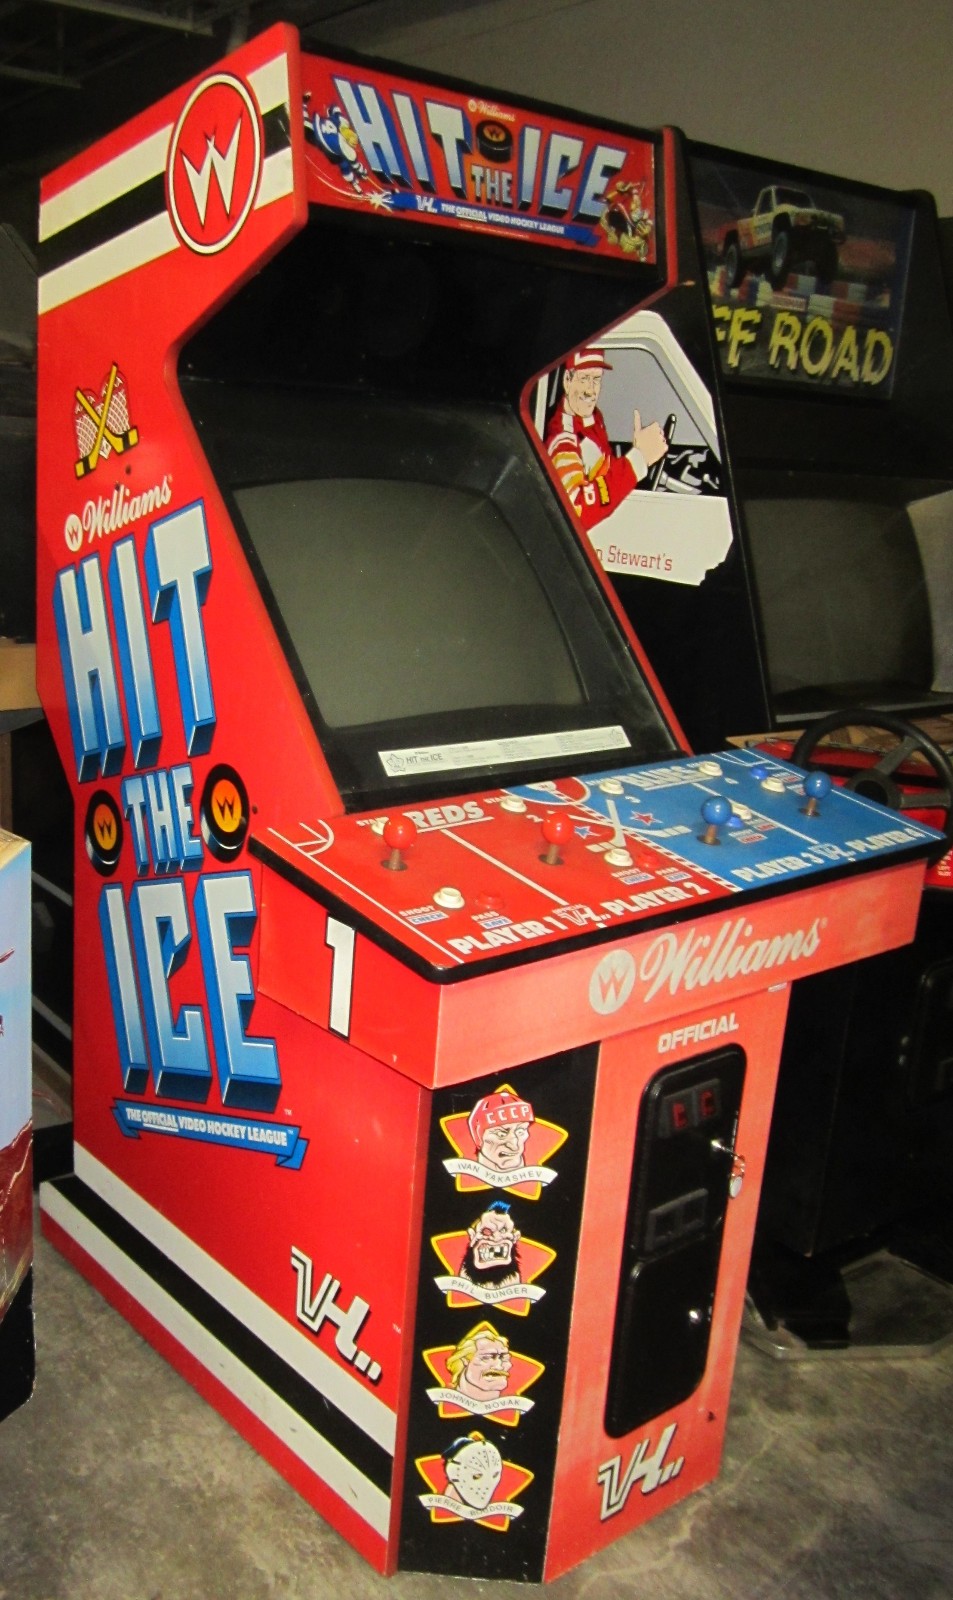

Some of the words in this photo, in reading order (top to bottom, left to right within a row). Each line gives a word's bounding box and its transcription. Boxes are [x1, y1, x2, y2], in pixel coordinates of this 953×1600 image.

[331, 74, 472, 200] HIT
[470, 164, 514, 207] THE
[517, 123, 628, 224] ICE
[441, 202, 457, 215] THE
[456, 206, 488, 222] OFFICIAL
[487, 212, 511, 225] VIDEO
[510, 216, 539, 230] HOCKEY
[538, 220, 565, 235] LEAGUE
[768, 311, 894, 386] ROAD
[82, 475, 173, 543] Williams
[607, 545, 673, 571] Stewart's
[53, 498, 217, 785] HIT
[120, 762, 205, 876] THE
[402, 801, 485, 828] REDS
[844, 830, 918, 854] PLAYER
[903, 827, 927, 839] 4
[730, 856, 812, 882] PLAYER
[800, 851, 825, 865] 3
[398, 905, 436, 917] SHOOT
[600, 886, 694, 916] PLAYER
[683, 881, 711, 896] 2
[446, 920, 554, 955] PLAYER
[543, 915, 569, 931] 1
[325, 915, 356, 1039] 1
[639, 918, 821, 1003] Williams
[98, 868, 283, 1114] ICE
[657, 1013, 740, 1054] OFFICIAL
[125, 1107, 142, 1123] THE
[142, 1110, 179, 1133] OFFICIAL
[177, 1115, 207, 1133] VIDEO
[207, 1120, 247, 1140] HOCKEY
[247, 1126, 288, 1147] LEAGUE
[485, 1104, 530, 1125] CCCP
[457, 1163, 481, 1174] IVAN
[484, 1170, 544, 1183] YAKASHEV
[451, 1279, 476, 1295] PHIL
[484, 1286, 529, 1301] BUNGER
[439, 1391, 479, 1409] JOHNNY
[484, 1398, 521, 1411] NOVAK
